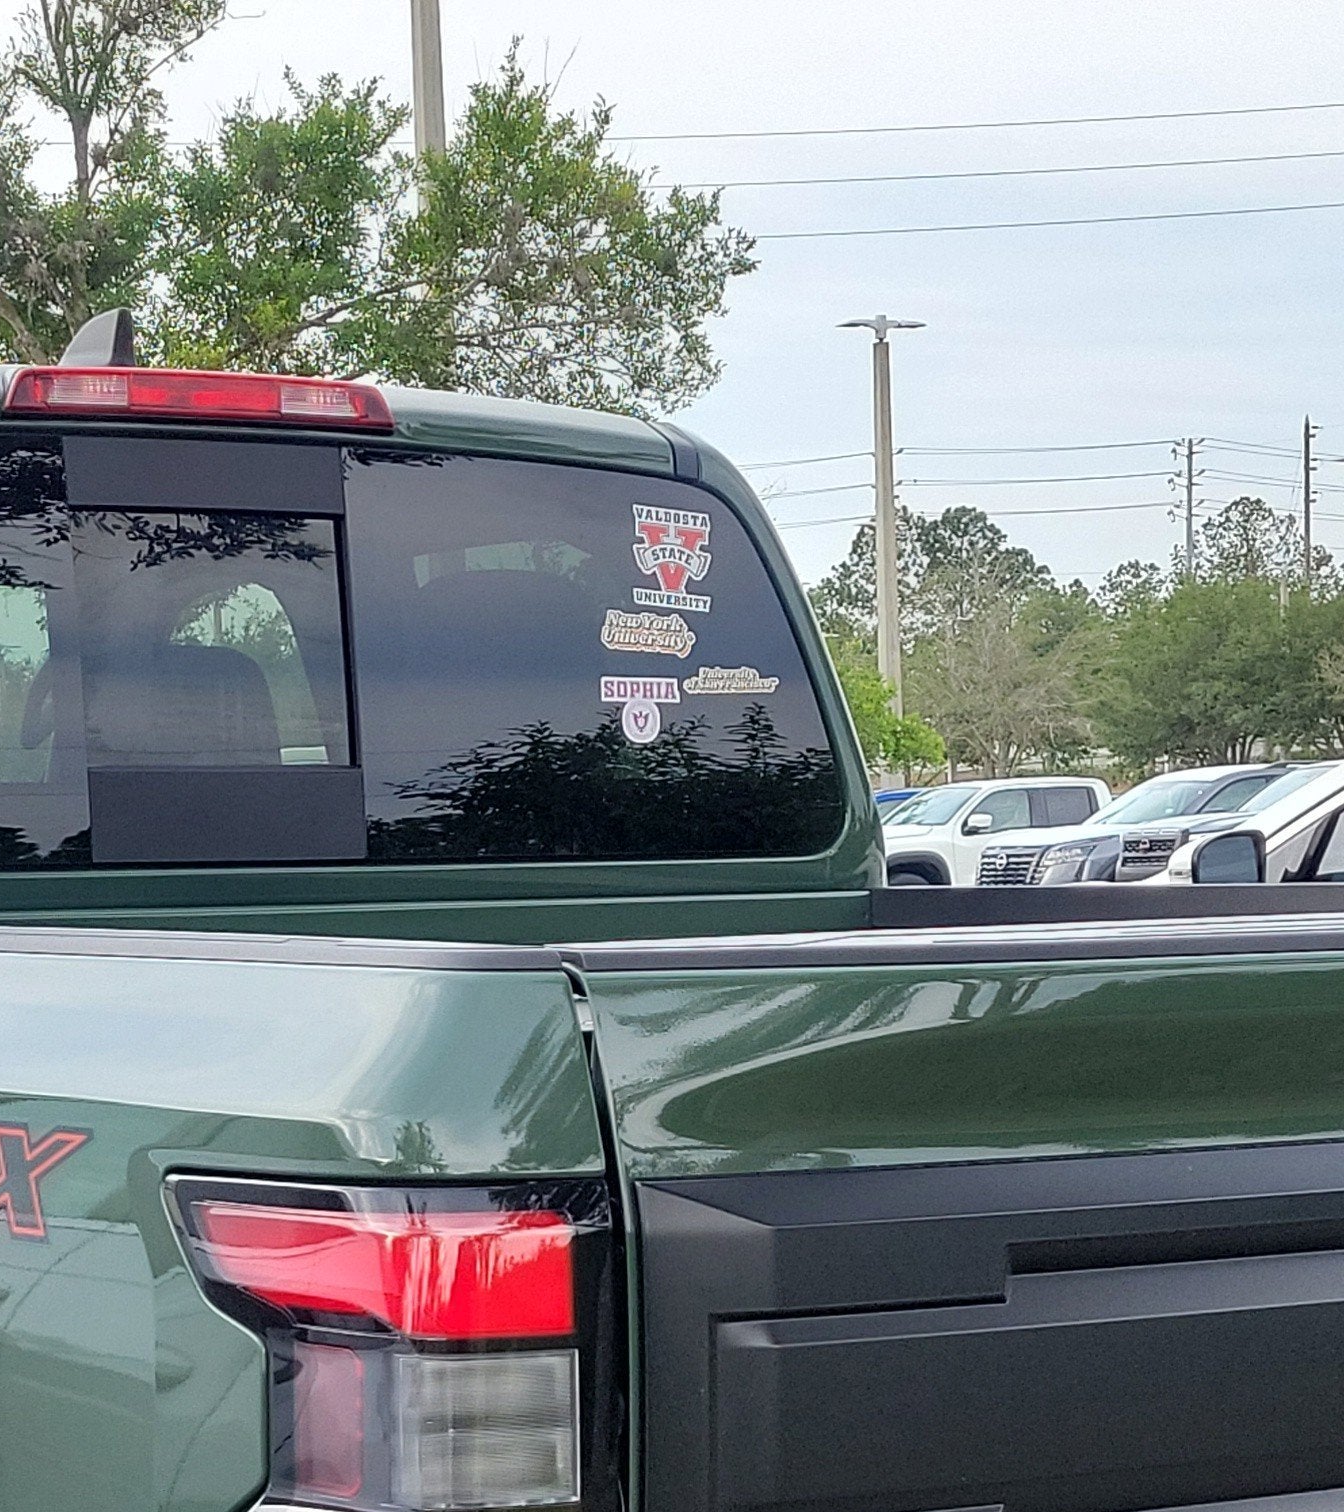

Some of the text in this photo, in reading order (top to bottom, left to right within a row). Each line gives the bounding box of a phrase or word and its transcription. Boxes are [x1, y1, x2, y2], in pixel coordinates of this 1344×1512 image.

[635, 507, 709, 528] VALDOSTA
[651, 547, 695, 567] STATE
[635, 590, 709, 610] UNIVERSITY
[607, 612, 685, 632] New York
[603, 681, 678, 700] SOPHIA
